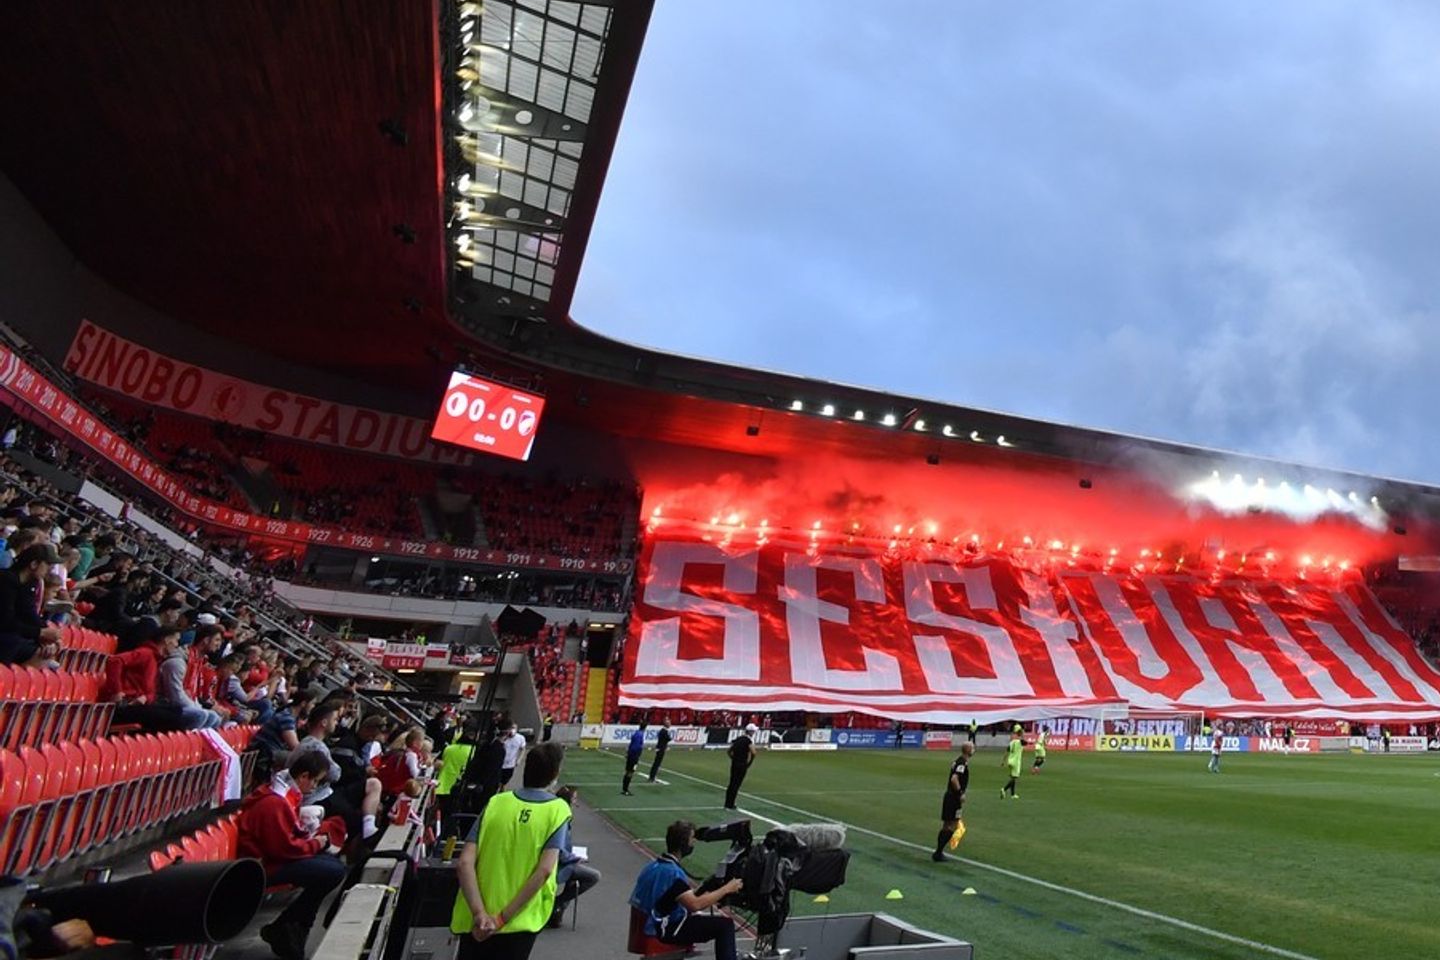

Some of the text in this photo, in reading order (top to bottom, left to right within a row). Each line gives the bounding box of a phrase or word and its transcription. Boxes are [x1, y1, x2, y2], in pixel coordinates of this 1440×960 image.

[64, 324, 203, 410] SINOBO
[266, 521, 287, 535] 1928
[308, 528, 331, 541] 1927
[351, 535, 373, 548] 1926
[401, 542, 427, 554] 1922
[453, 548, 479, 560] 1912
[506, 554, 531, 565] 1911
[560, 558, 585, 569] 1910
[389, 657, 420, 667] GIRLS
[677, 729, 699, 741] PRO
[1138, 720, 1184, 736] SEVER
[1101, 737, 1171, 749] FORTUNA
[519, 809, 532, 824] 15
